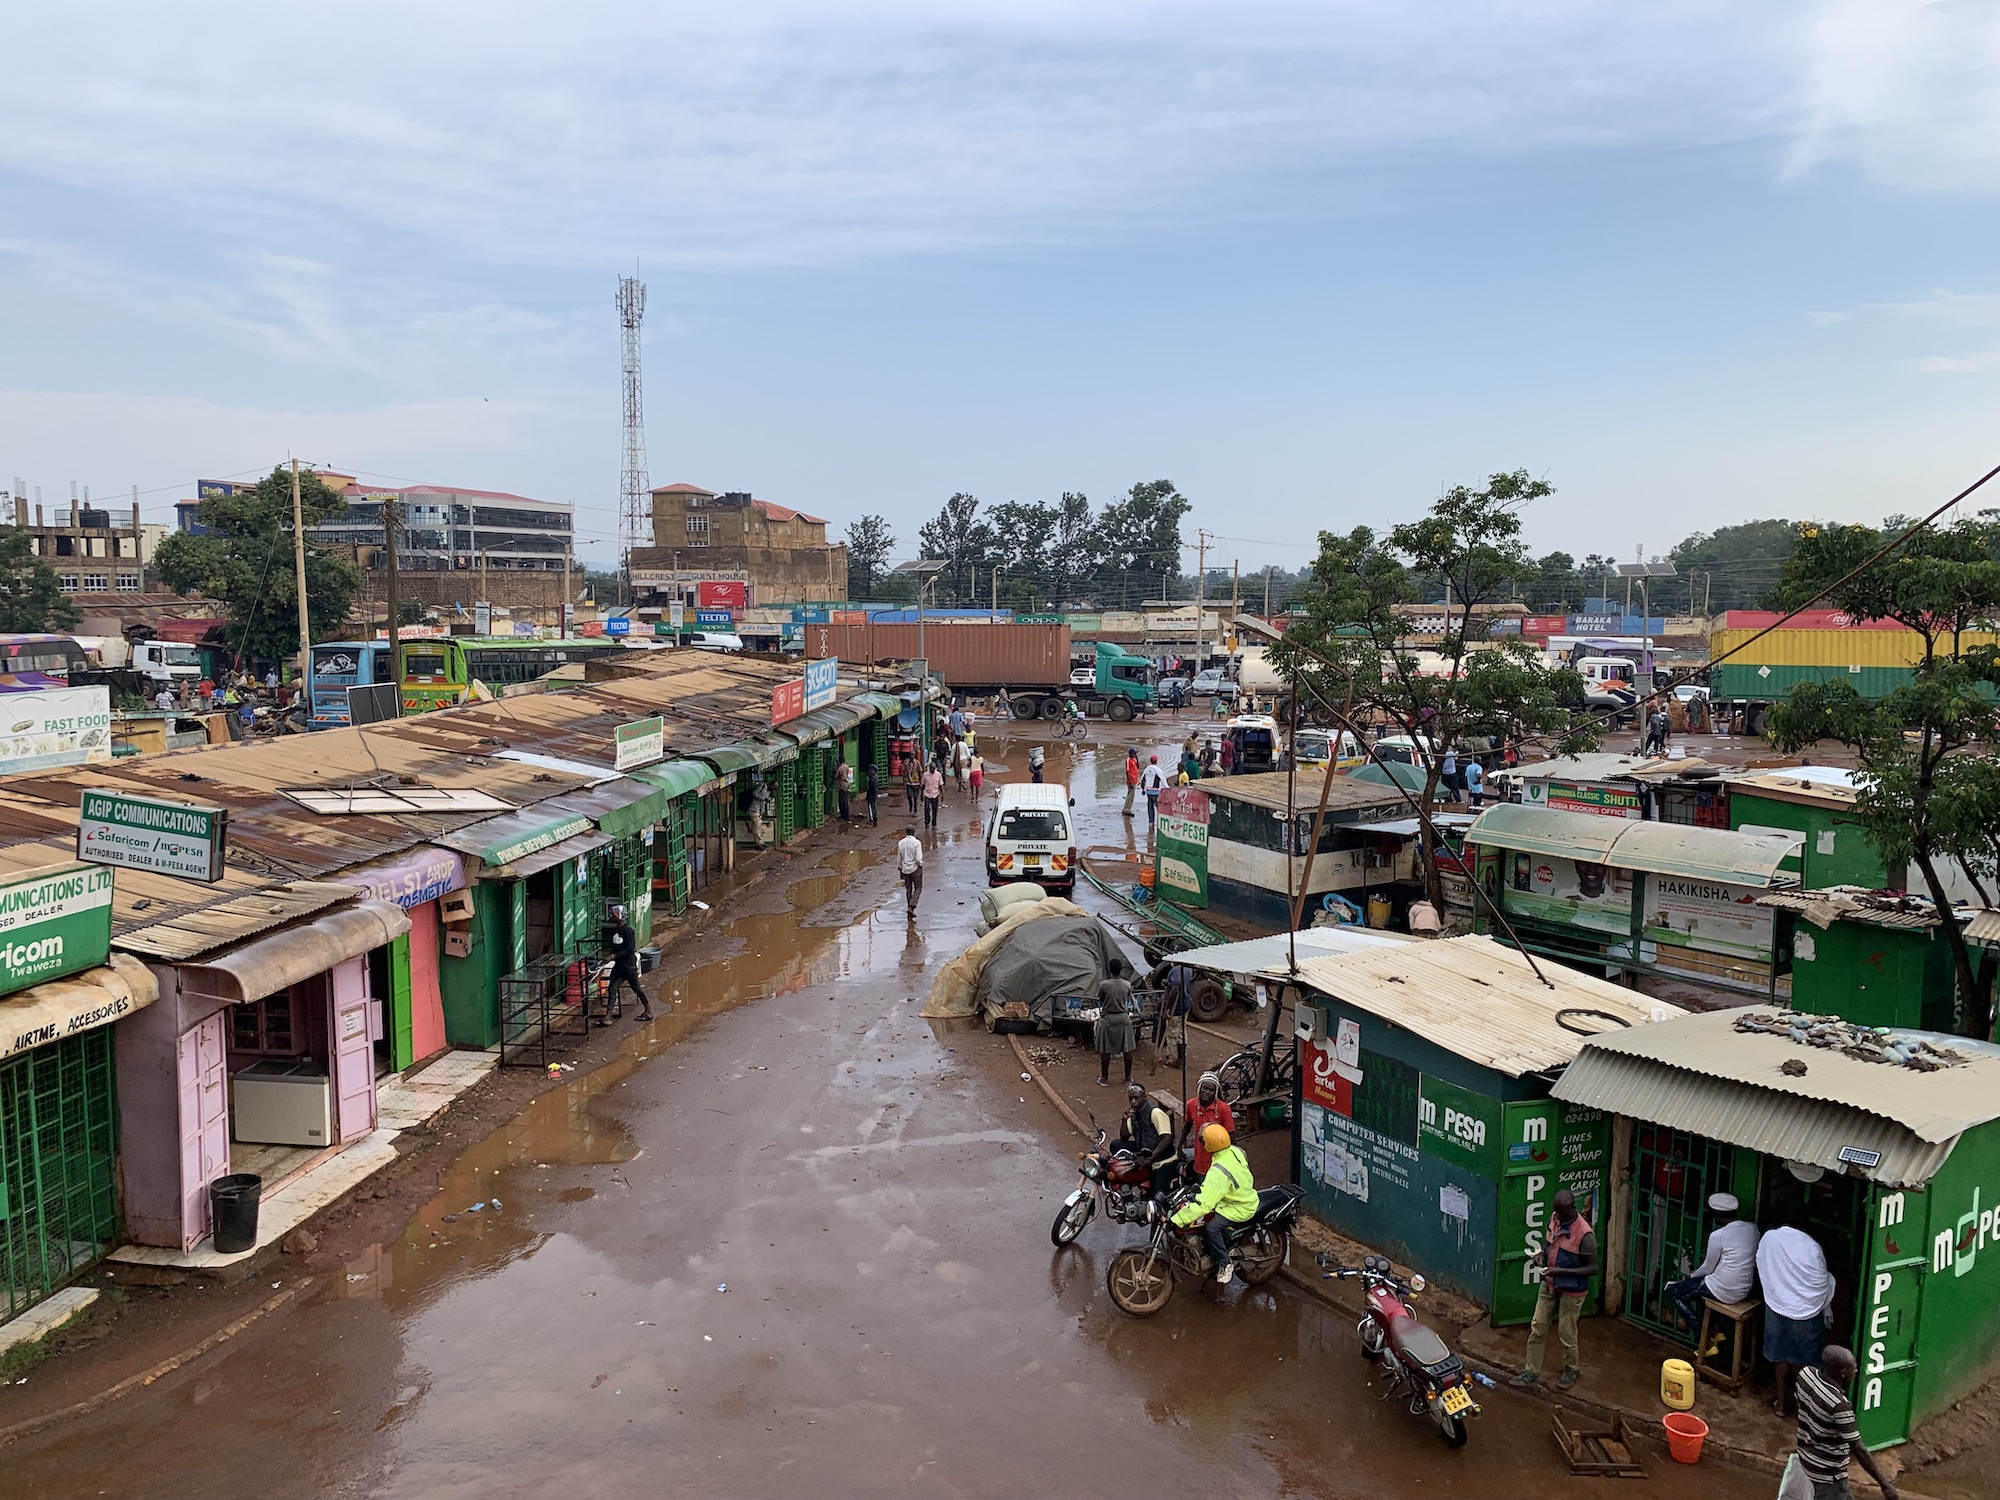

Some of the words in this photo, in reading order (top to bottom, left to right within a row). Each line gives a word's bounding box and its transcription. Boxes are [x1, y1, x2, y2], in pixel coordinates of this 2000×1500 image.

[610, 622, 628, 630] TECNO
[699, 613, 729, 622] TECNO
[1576, 616, 1611, 624] BARAKA
[44, 717, 74, 732] FAST
[77, 714, 109, 728] FOOD
[1577, 791, 1600, 800] CLASSIC
[1171, 800, 1193, 814] airtel
[1548, 801, 1568, 810] BUSIA
[1569, 803, 1599, 814] BOOKING
[1601, 807, 1627, 817] OFFICE
[88, 799, 113, 818] AGIP
[114, 803, 207, 835] COMMUNICATIONS
[98, 830, 149, 848] Safaricom
[85, 846, 124, 860] AUTHORISED
[128, 854, 153, 865] DEALER
[155, 858, 160, 866] &
[161, 860, 184, 871] M-PESA
[184, 863, 206, 875] AGENT
[496, 841, 527, 864] PHONE
[426, 860, 455, 886] SHOP
[397, 878, 452, 909] COSMETIC
[1658, 880, 1731, 902] HAKIKISHA
[25, 903, 64, 921] DEALER
[10, 957, 62, 979] Twaweza
[67, 996, 129, 1032] ACCESSORIES
[1314, 1074, 1336, 1091] airtel
[1314, 1085, 1336, 1105] Money
[1564, 1110, 1602, 1124] 024398
[1443, 1106, 1486, 1147] PESA
[1328, 1113, 1375, 1143] COMPUTER
[1376, 1133, 1420, 1162] SERVICES
[1561, 1131, 1593, 1145] LINES
[1561, 1143, 1582, 1156] SIM
[1570, 1149, 1602, 1164] SWAP
[1558, 1168, 1600, 1183] SCRATCH
[1864, 1272, 1893, 1412] PESA
